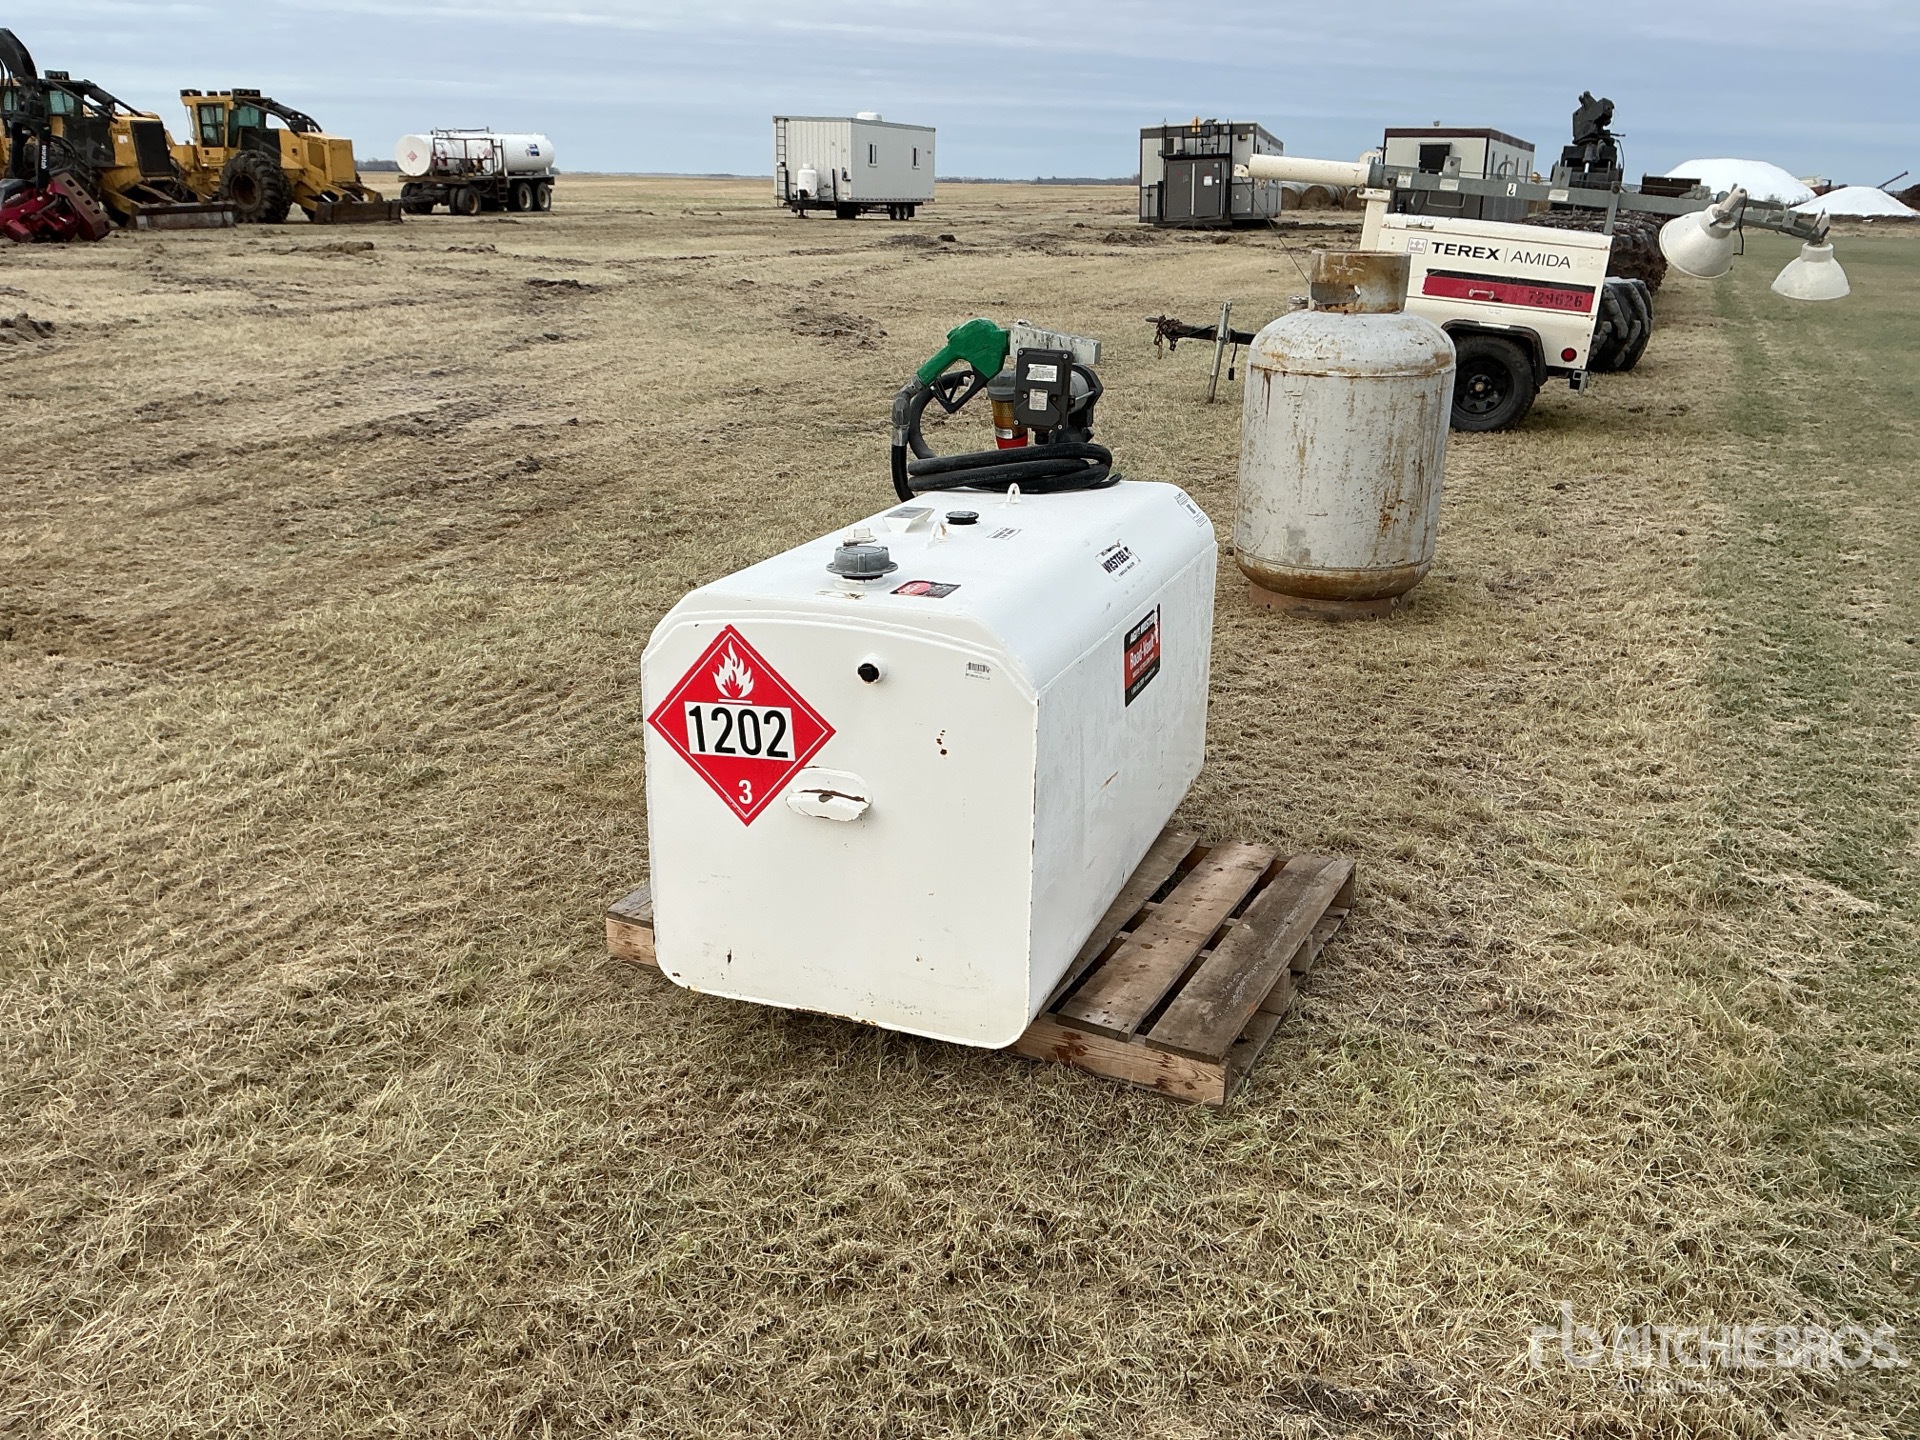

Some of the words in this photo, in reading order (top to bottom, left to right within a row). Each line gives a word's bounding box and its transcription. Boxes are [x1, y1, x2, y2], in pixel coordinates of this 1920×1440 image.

[1431, 241, 1500, 261] TEREX
[1510, 250, 1571, 269] AMIDA
[1527, 290, 1583, 308] 729626
[1102, 549, 1130, 574] WESTEEL
[688, 705, 789, 758] 1202
[738, 779, 753, 804] 3
